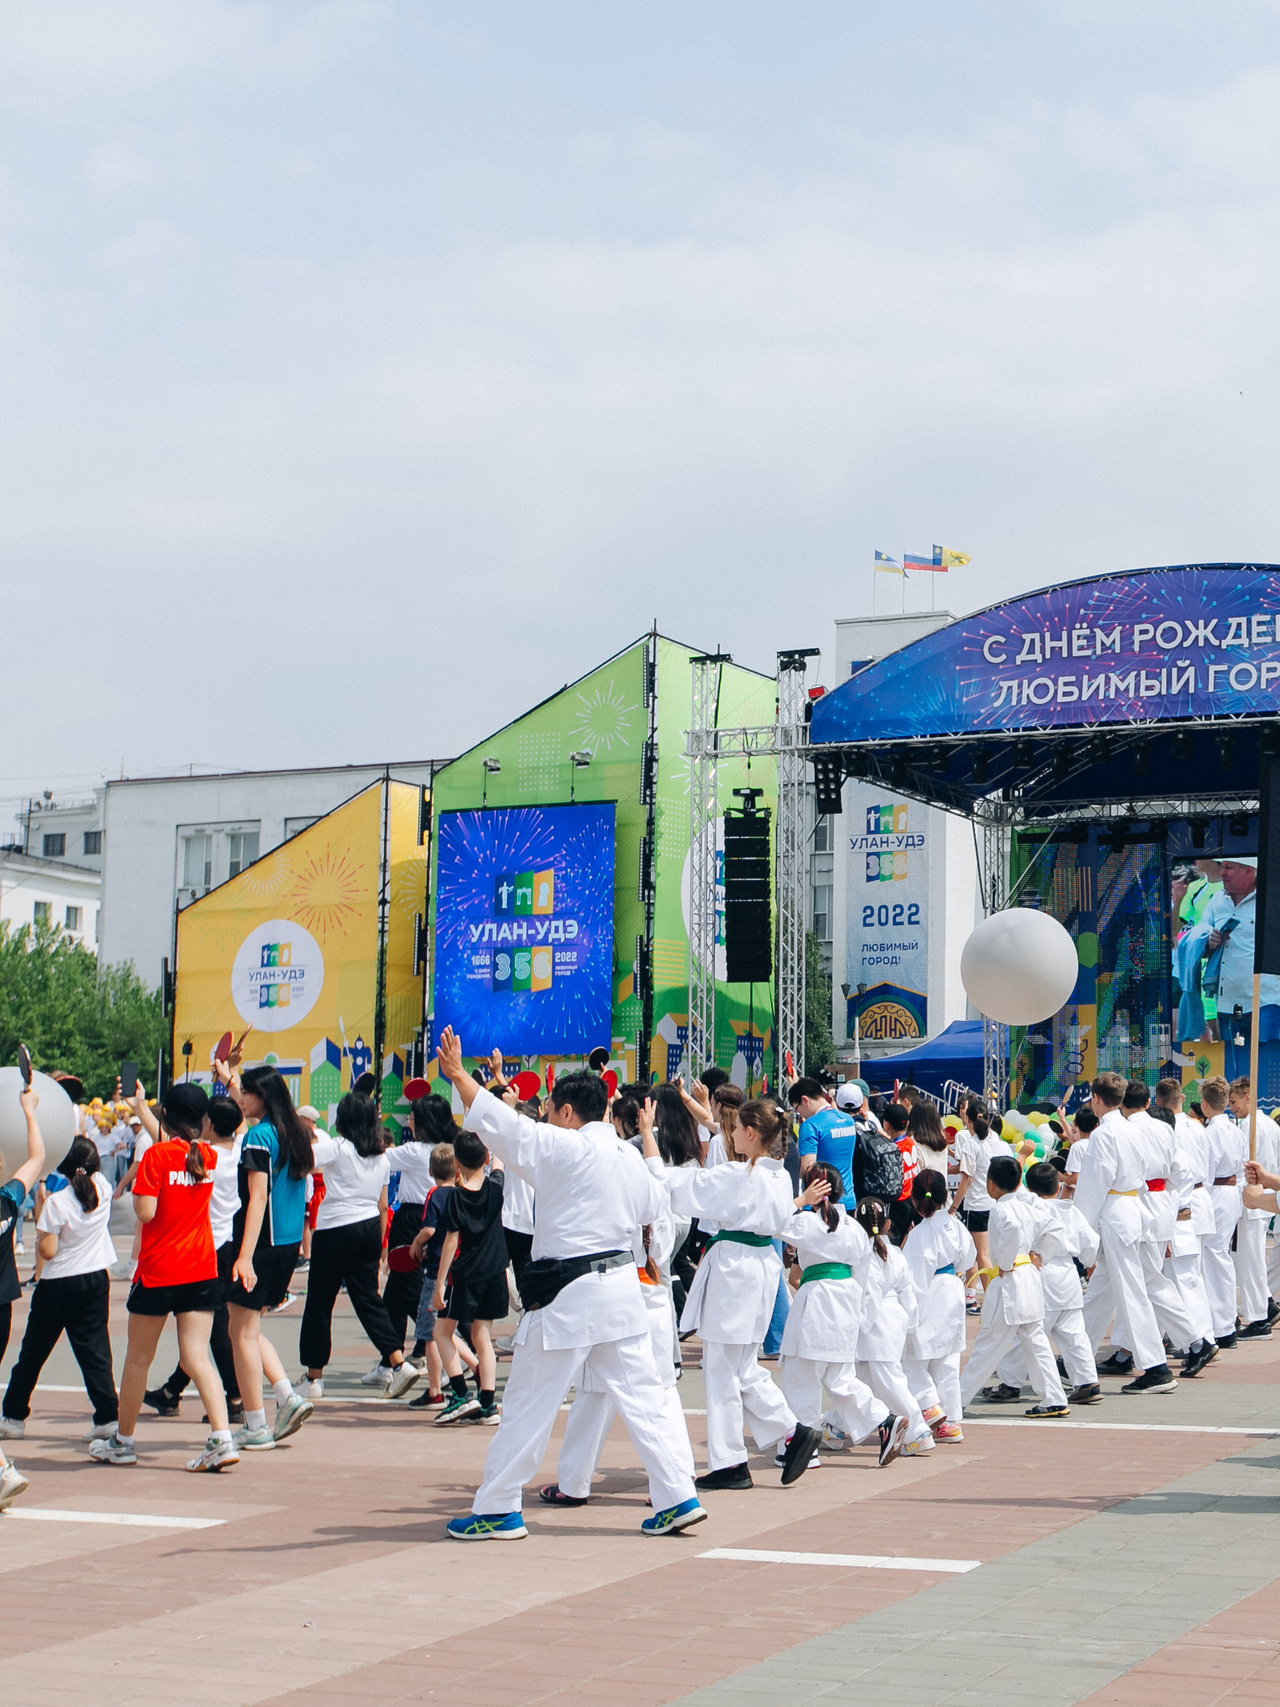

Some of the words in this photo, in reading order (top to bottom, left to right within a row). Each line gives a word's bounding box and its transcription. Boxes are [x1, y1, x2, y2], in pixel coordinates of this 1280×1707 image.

[983, 634, 1007, 664] С
[1015, 621, 1123, 666] ДНЁМ
[993, 659, 1196, 708] ЛЮБИМЫЙ
[849, 834, 926, 850] УЛАН-УДЭ
[862, 903, 921, 927] 2022
[469, 919, 579, 943] УЛАН-УДЭ
[861, 940, 919, 952] ЛЮБИМЫЙ
[471, 954, 491, 966] 1666
[554, 951, 578, 962] 2022
[861, 956, 901, 966] ГОРОД!
[248, 969, 305, 982] УЛАН-УДЭ
